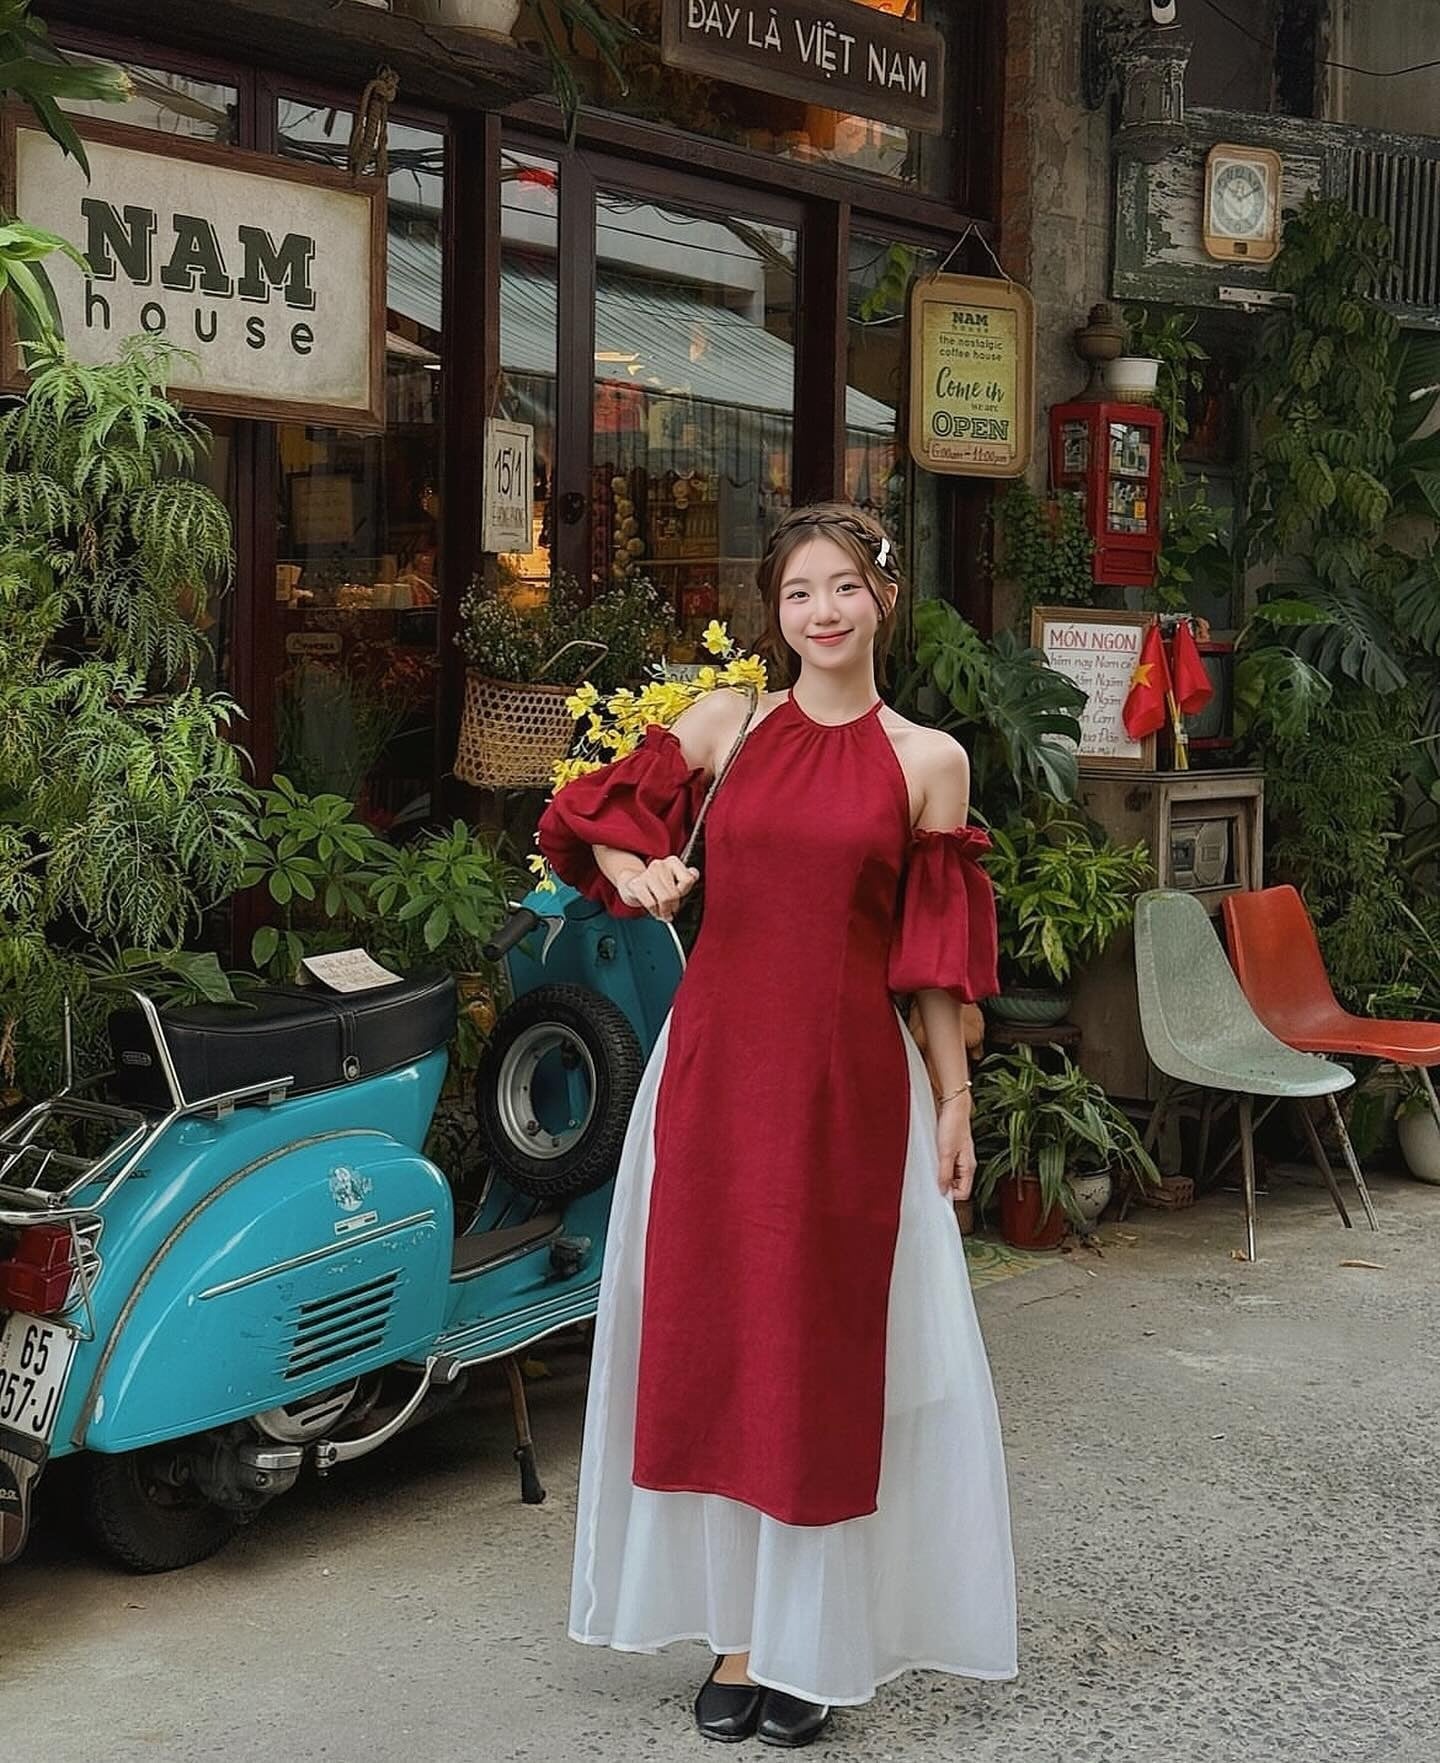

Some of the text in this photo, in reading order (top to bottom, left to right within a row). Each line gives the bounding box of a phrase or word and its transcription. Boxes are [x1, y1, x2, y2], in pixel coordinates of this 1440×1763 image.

[748, 7, 782, 53] LÀ
[794, 20, 856, 78] VIỆT
[867, 43, 928, 98] NAM
[81, 197, 316, 311] NAM
[85, 278, 315, 355] house
[952, 311, 989, 326] NAM
[939, 348, 1002, 362] coffee house
[940, 335, 1003, 351] the nostalgic
[936, 366, 1005, 403] Come in
[932, 410, 1009, 440] OPEN
[1050, 625, 1138, 651] MÓN NGON
[20, 1324, 54, 1376] 65
